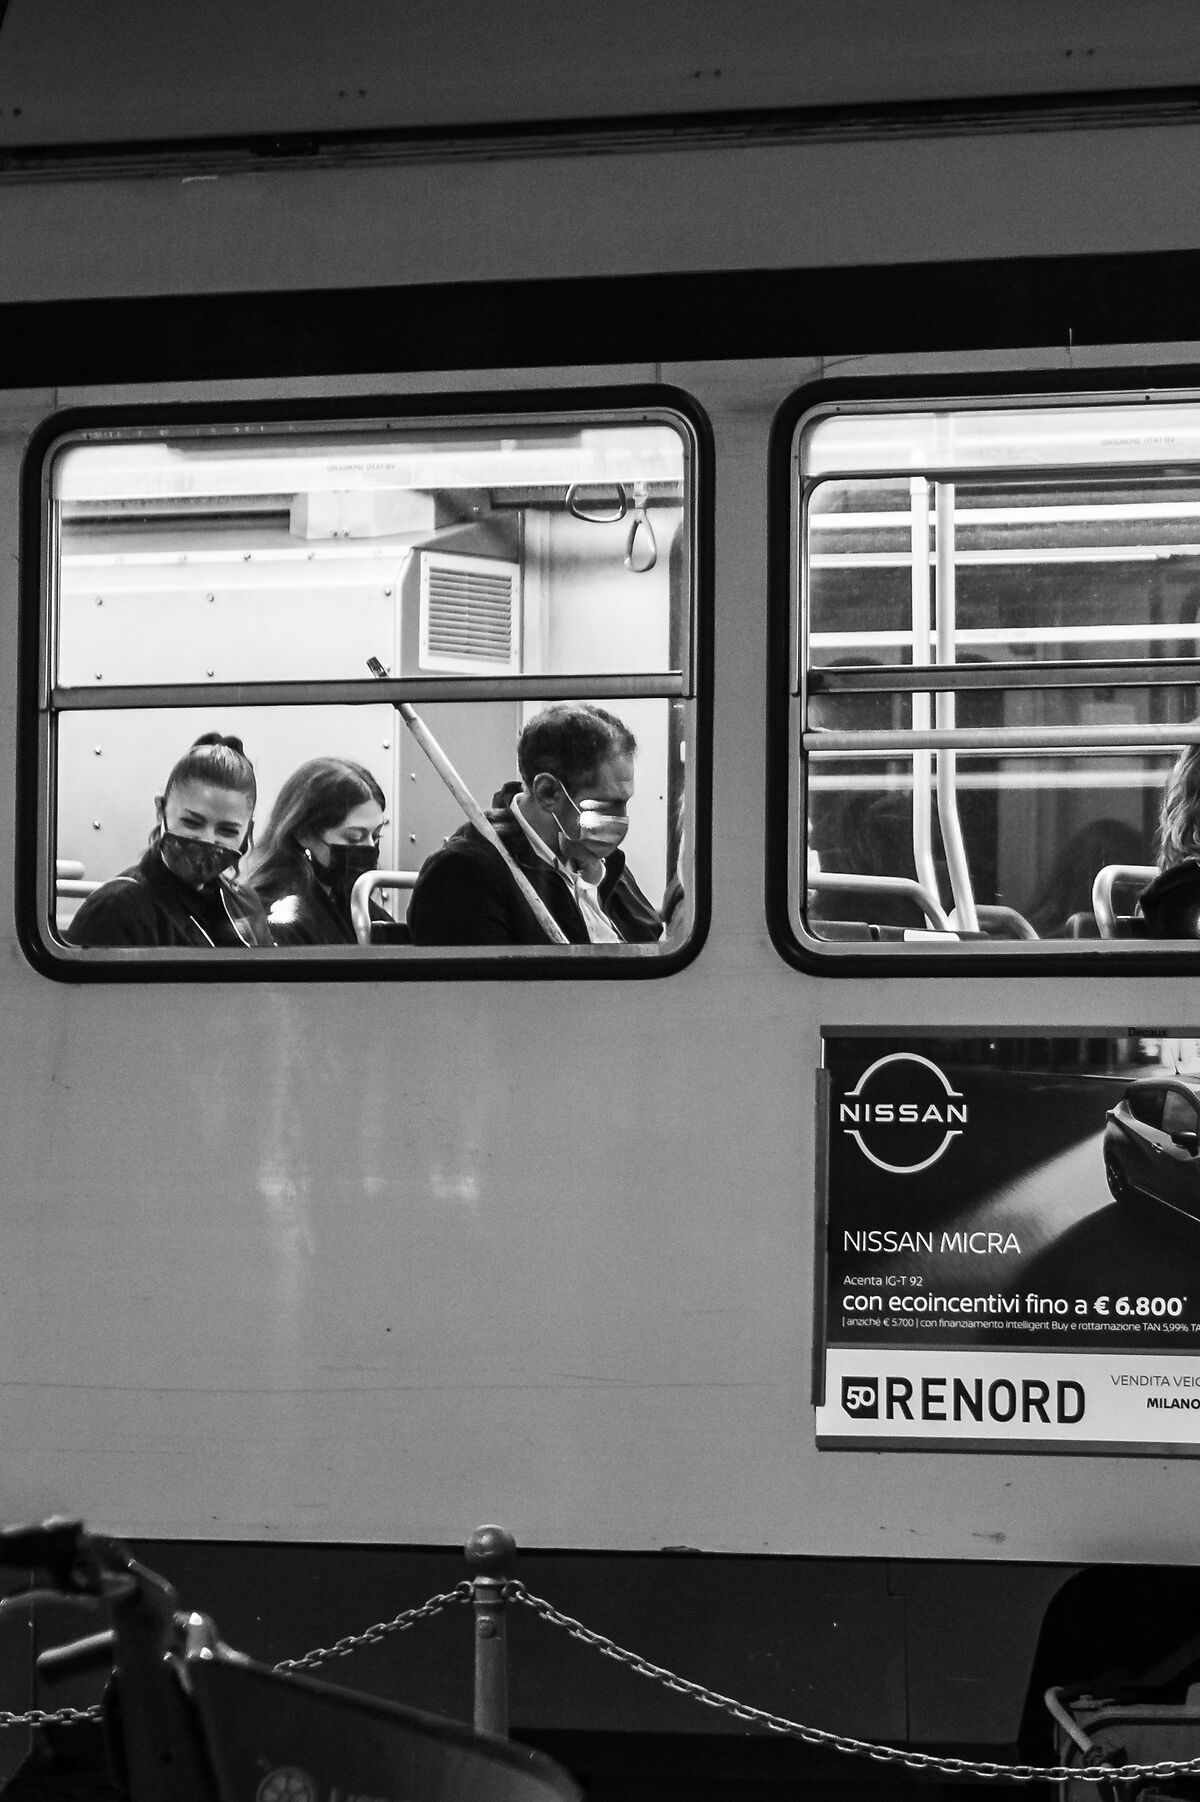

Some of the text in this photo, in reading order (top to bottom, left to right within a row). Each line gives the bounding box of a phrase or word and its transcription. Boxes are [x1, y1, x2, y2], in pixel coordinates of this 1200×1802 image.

[840, 1103, 967, 1123] NISSAN
[843, 1230, 1021, 1254] NISSAN MICRA
[843, 1275, 883, 1286] Acenta
[909, 1276, 923, 1287] 92
[842, 1295, 882, 1311] con
[888, 1293, 1020, 1313] ecoincentivi
[1025, 1293, 1068, 1314] fino
[1074, 1299, 1088, 1315] a
[1093, 1296, 1110, 1315] €
[883, 1317, 890, 1327] €
[920, 1319, 938, 1327] con
[939, 1318, 1004, 1329] finanziamento
[1005, 1320, 1050, 1331] Intelligent
[1051, 1321, 1069, 1331] Buy
[1070, 1322, 1077, 1330] e
[1078, 1321, 1141, 1331] rottamazione
[1142, 1322, 1161, 1332] TAN
[1162, 1322, 1189, 1333] 5,99%
[1111, 1374, 1170, 1387] VENDITA
[846, 1386, 876, 1410] 50
[886, 1376, 1086, 1424] RENORD
[1146, 1397, 1200, 1410] MILANO
